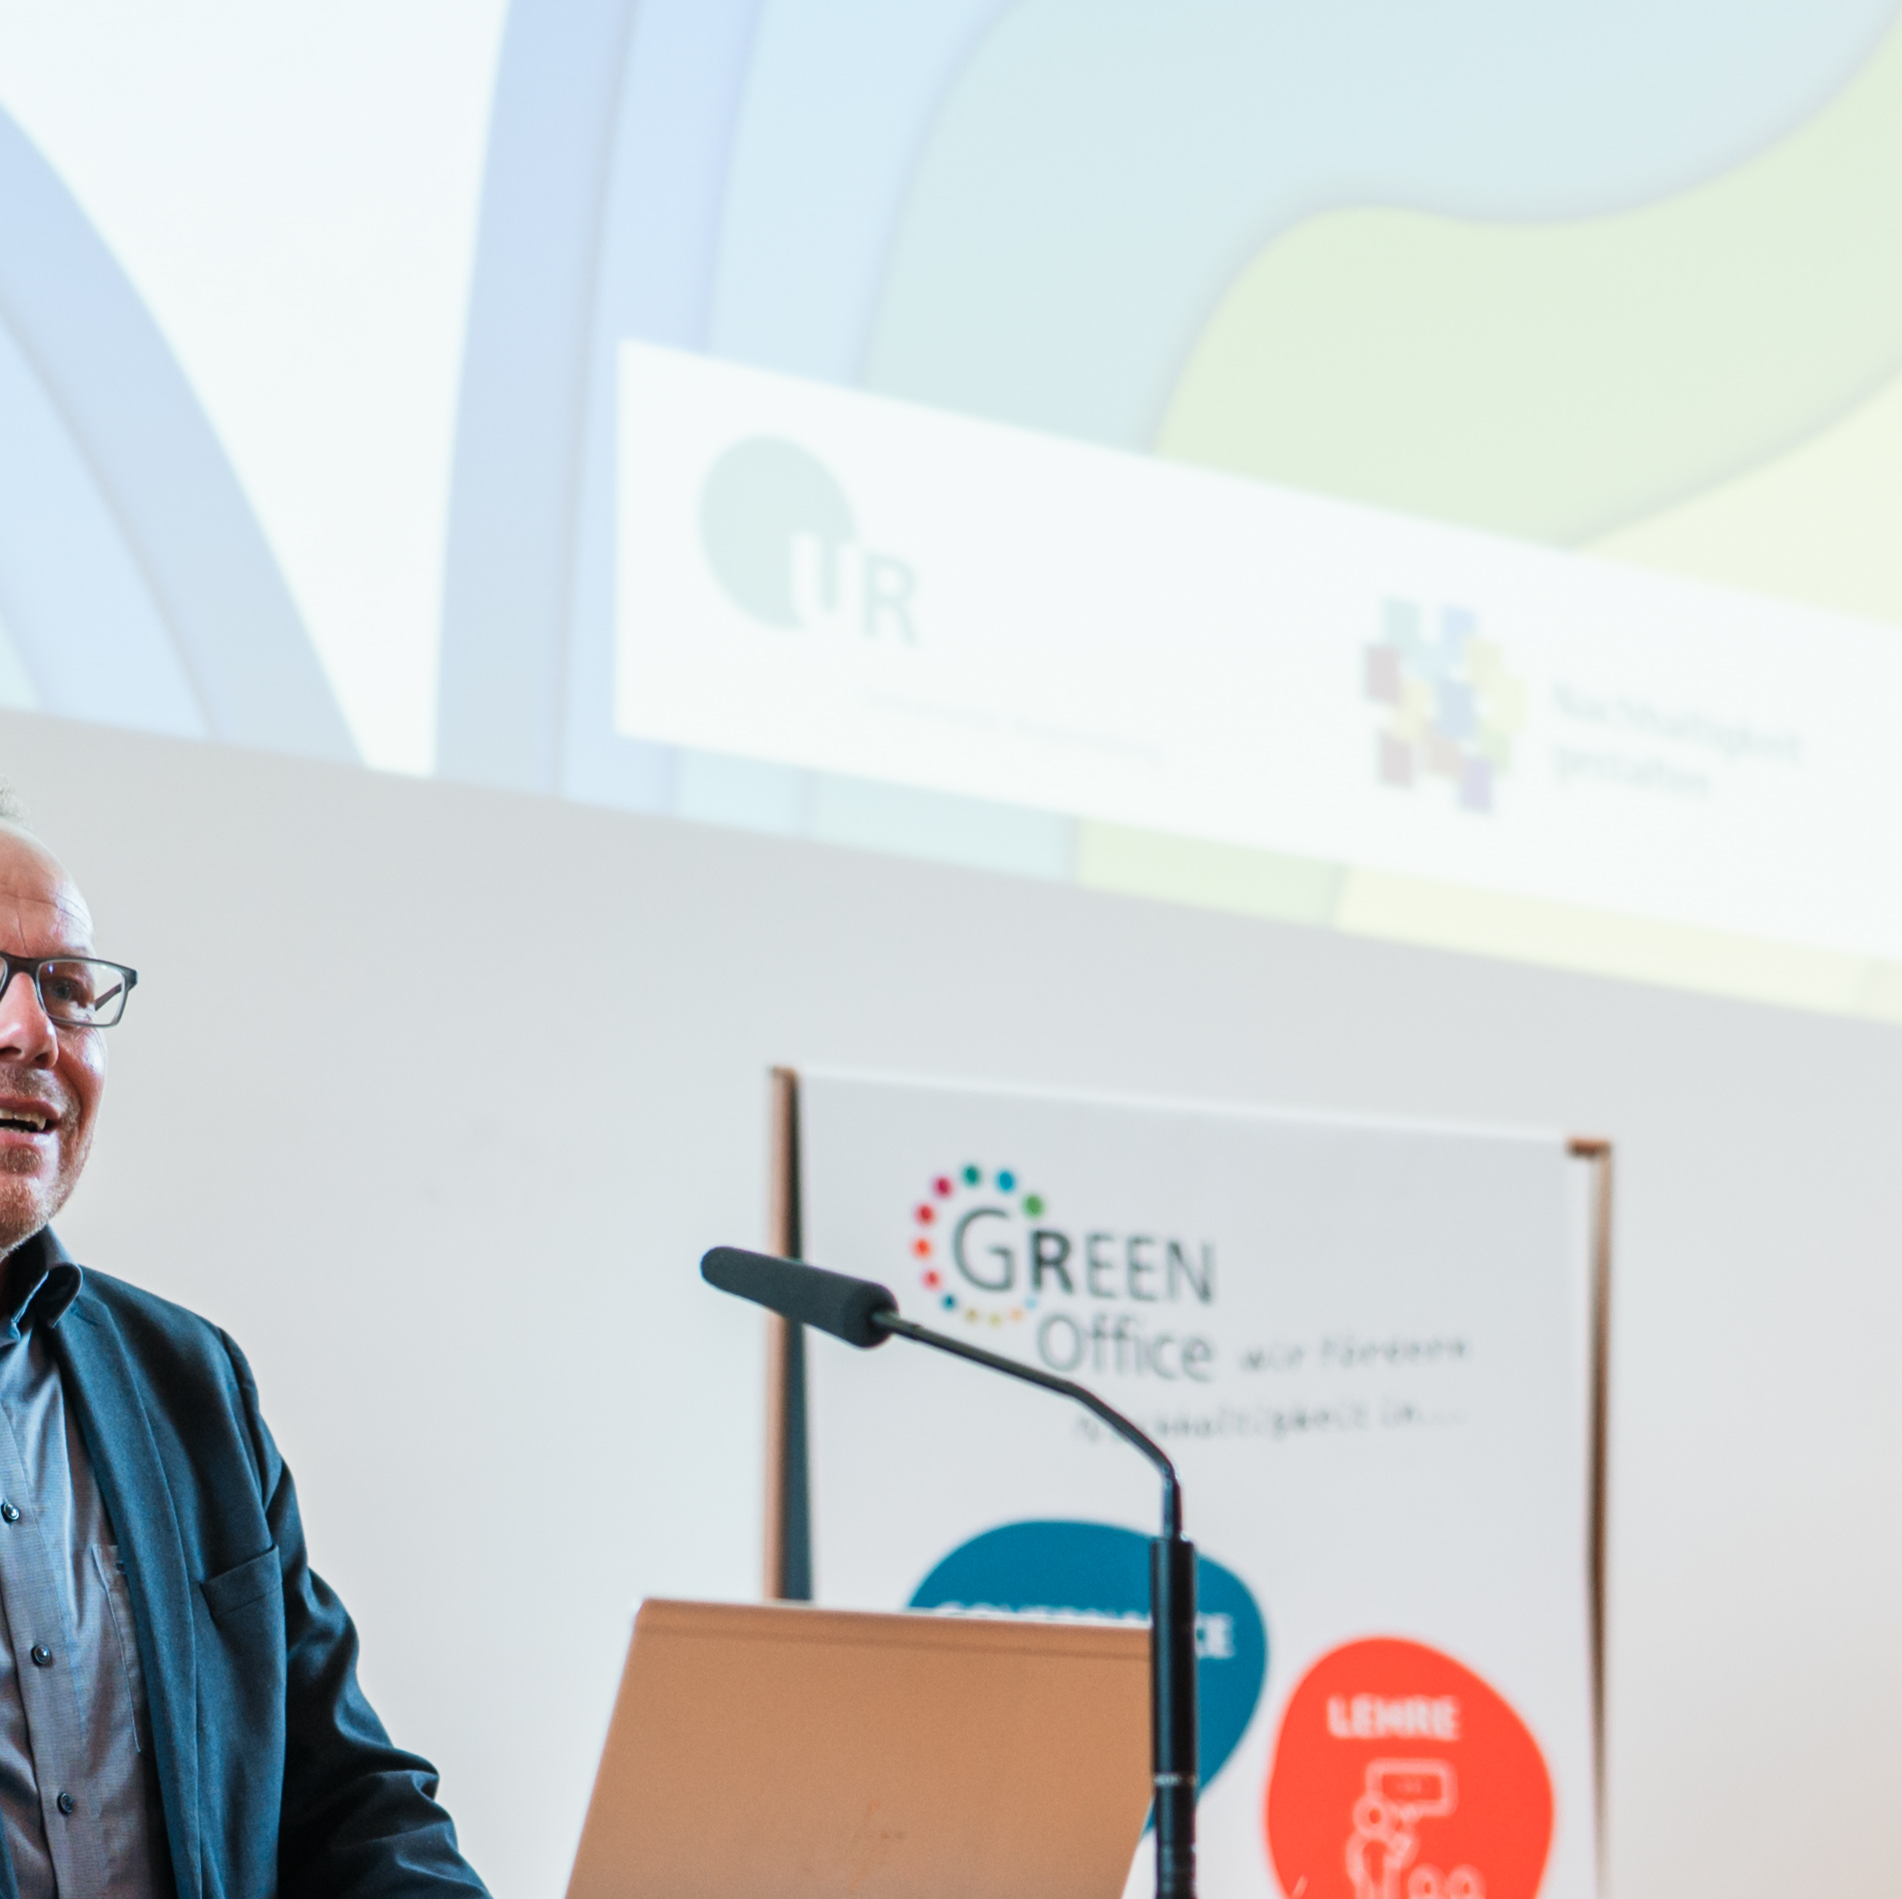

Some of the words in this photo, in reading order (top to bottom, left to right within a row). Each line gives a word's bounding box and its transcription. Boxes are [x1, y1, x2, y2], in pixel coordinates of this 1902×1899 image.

[951, 1205, 1217, 1306] GREEN
[1035, 1312, 1217, 1383] Office
[1326, 1693, 1460, 1740] LEHRE
